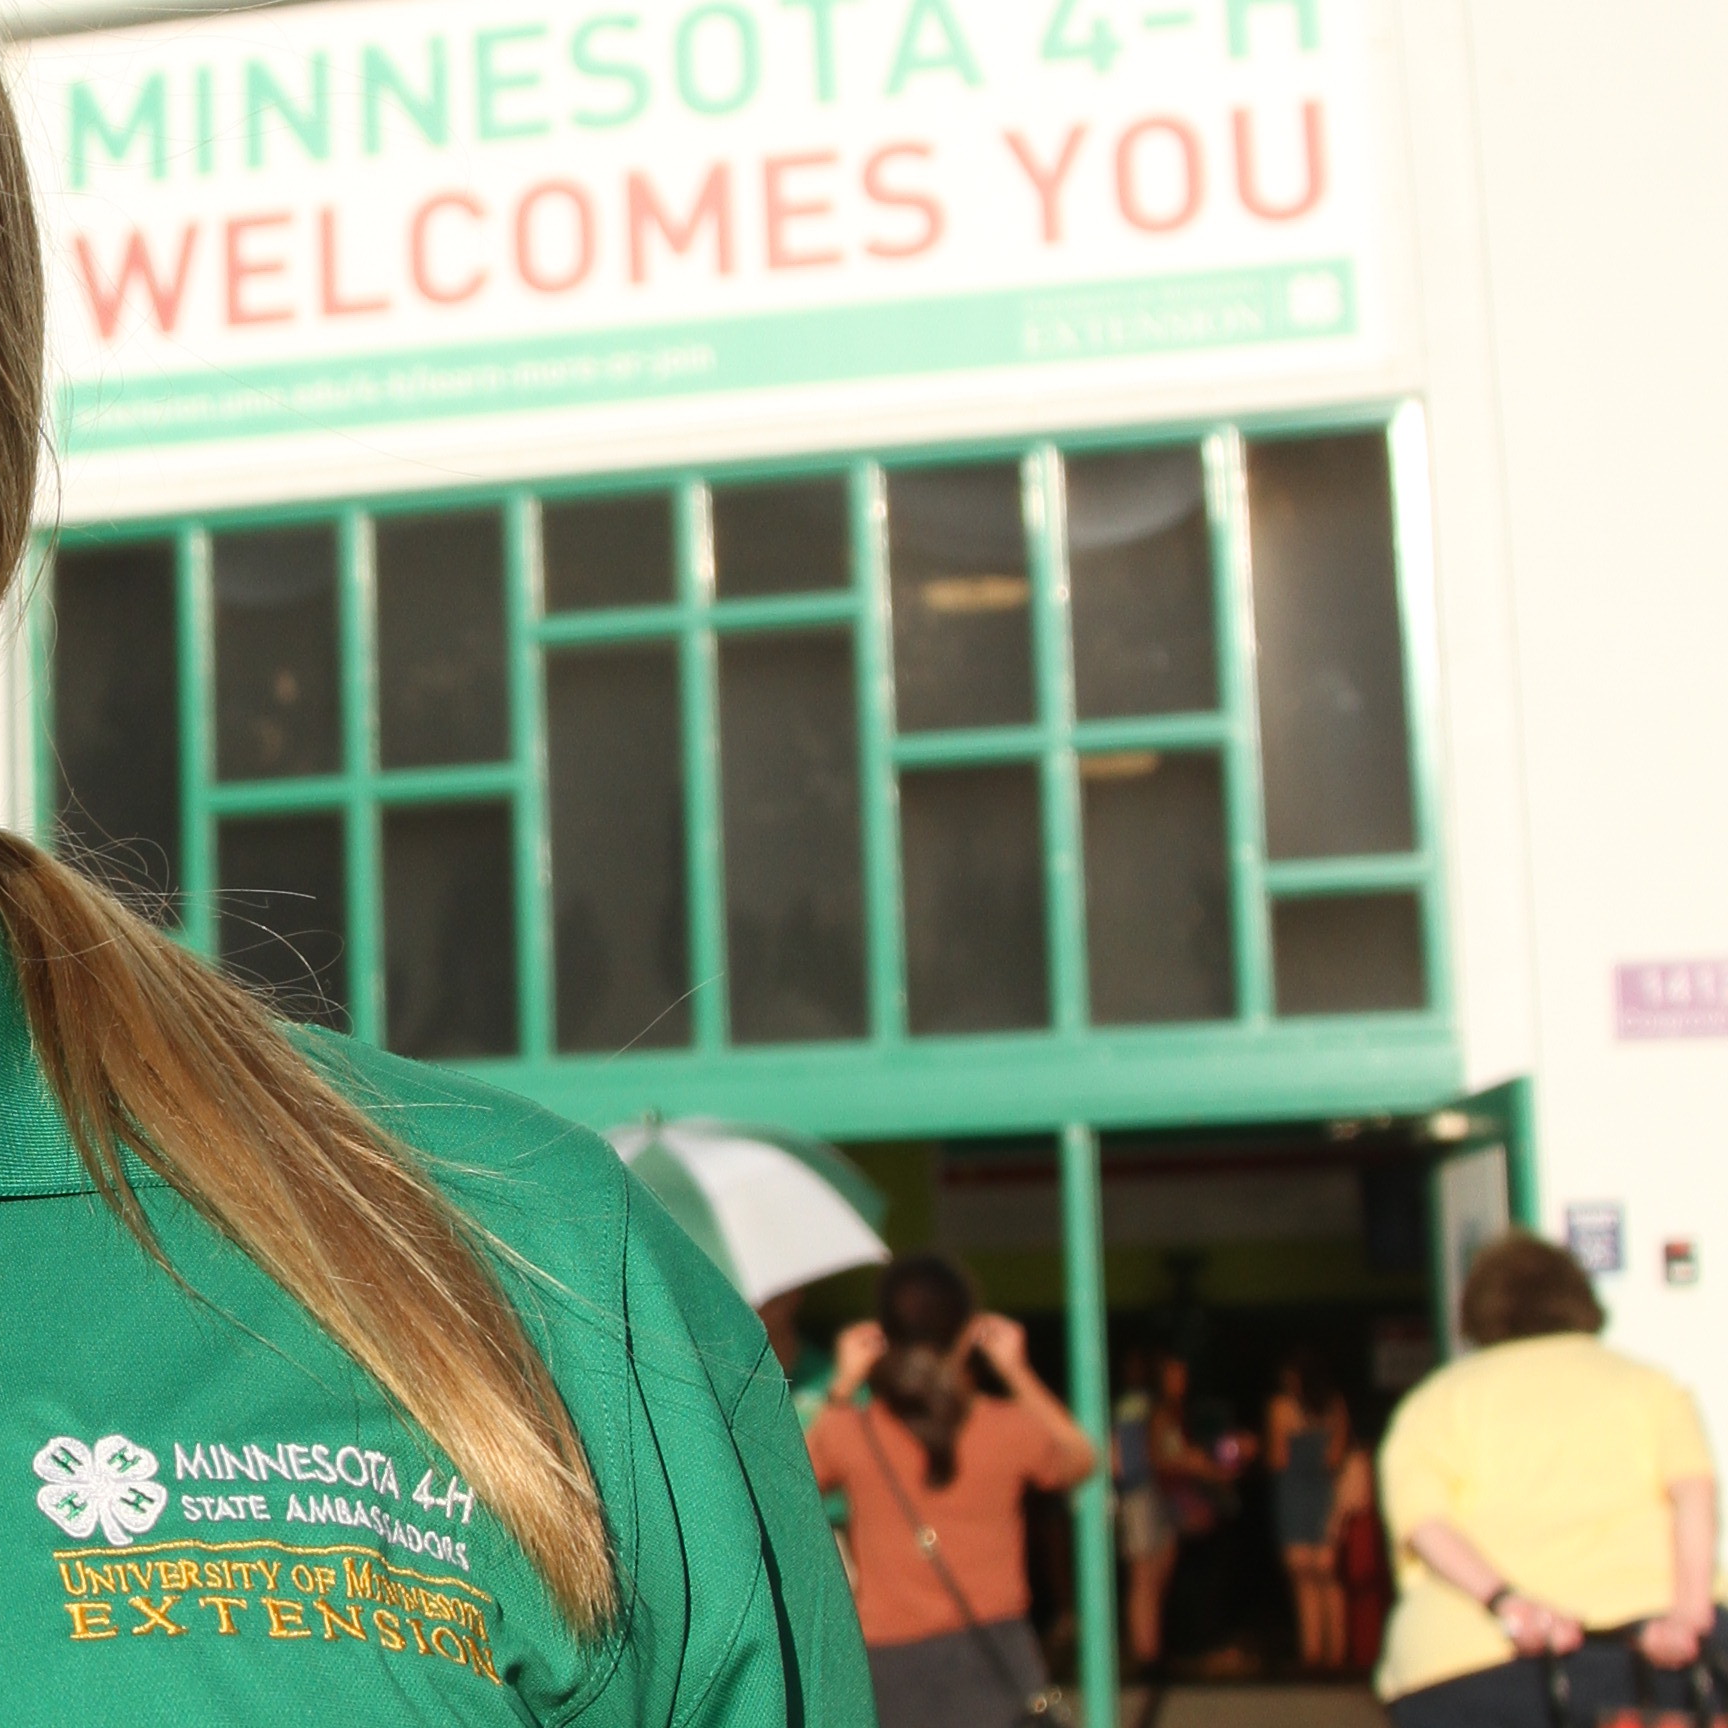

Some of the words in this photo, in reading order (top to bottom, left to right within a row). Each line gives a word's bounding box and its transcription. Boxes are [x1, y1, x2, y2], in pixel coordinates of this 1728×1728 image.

[73, 139, 946, 341] WELCOMES
[1001, 99, 1329, 246] YOU
[51, 1446, 82, 1473] H
[109, 1446, 141, 1472] H
[173, 1443, 401, 1500] MINNESOTA
[55, 1492, 87, 1520] H
[122, 1488, 155, 1514] H
[181, 1494, 271, 1522] STATE
[286, 1494, 470, 1571] AMBASSADORS
[64, 1597, 502, 1686] EXTENSION
